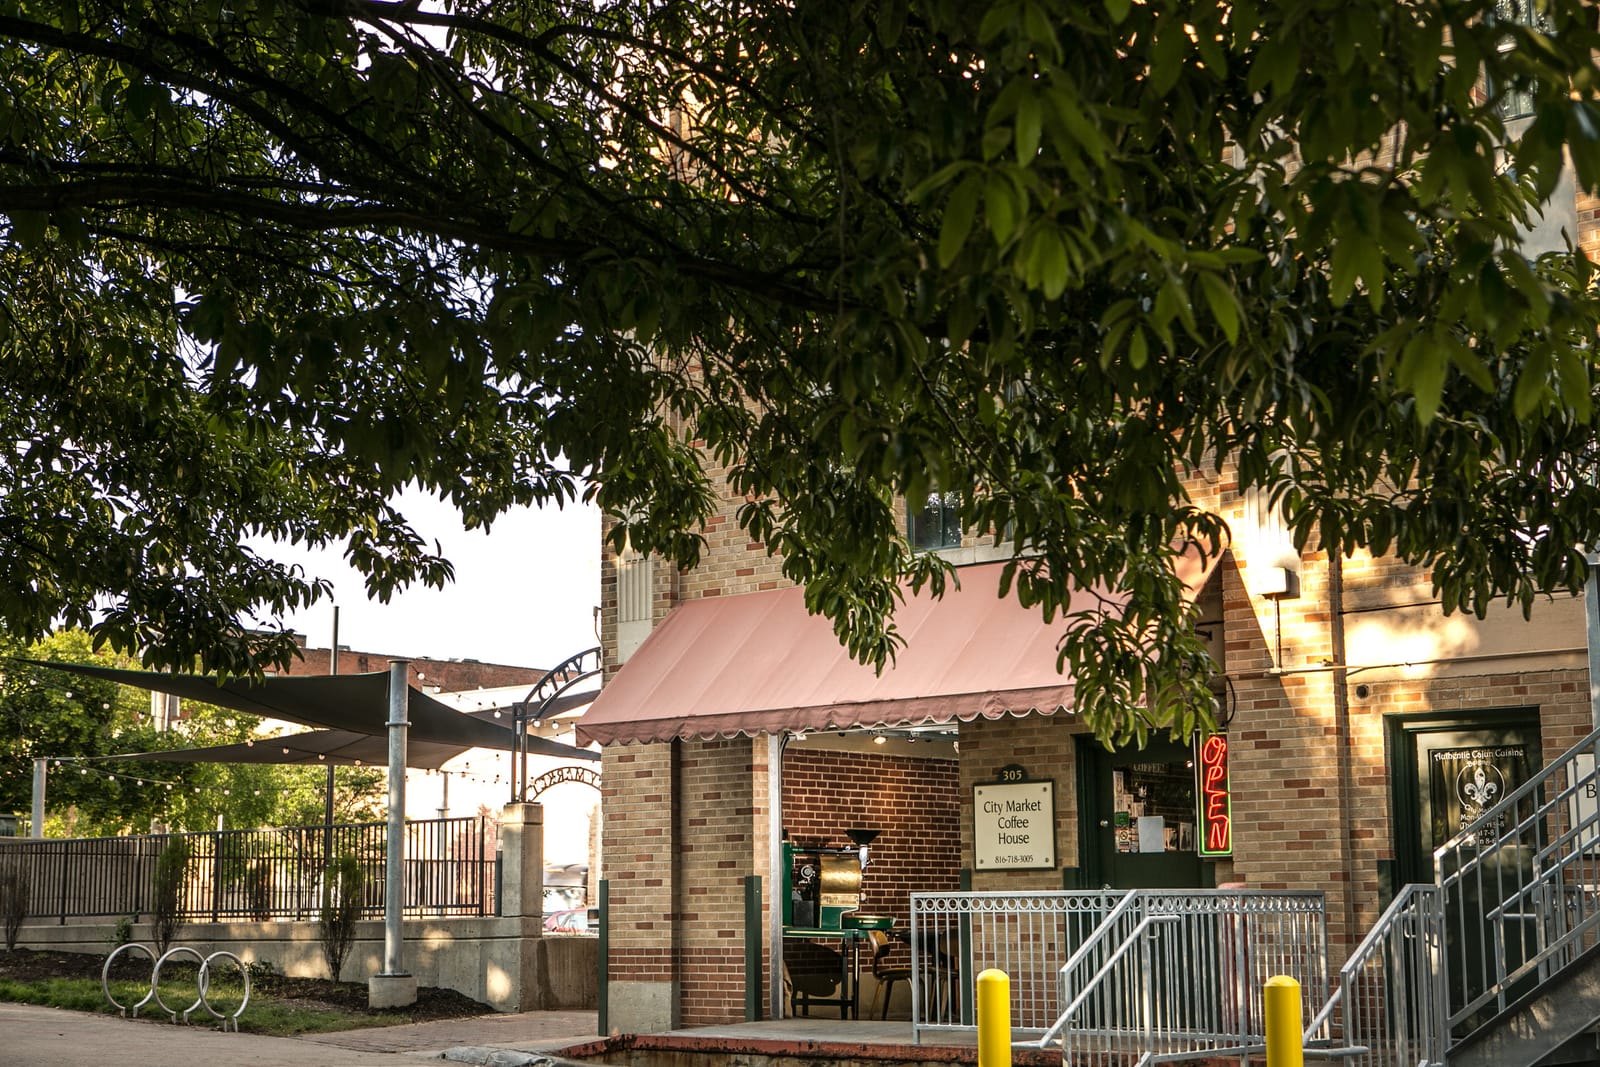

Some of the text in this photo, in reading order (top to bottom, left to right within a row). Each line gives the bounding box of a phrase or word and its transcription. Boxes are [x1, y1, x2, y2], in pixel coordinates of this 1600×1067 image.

[538, 655, 584, 701] CITY
[1434, 747, 1523, 762] Authentic Cajun Cuisine
[1002, 770, 1022, 781] 305
[1203, 735, 1227, 849] OPEN
[983, 798, 1042, 816] City Market
[997, 815, 1030, 829] Coffee
[998, 832, 1030, 845] House
[994, 854, 1034, 864] 816-718-3005
